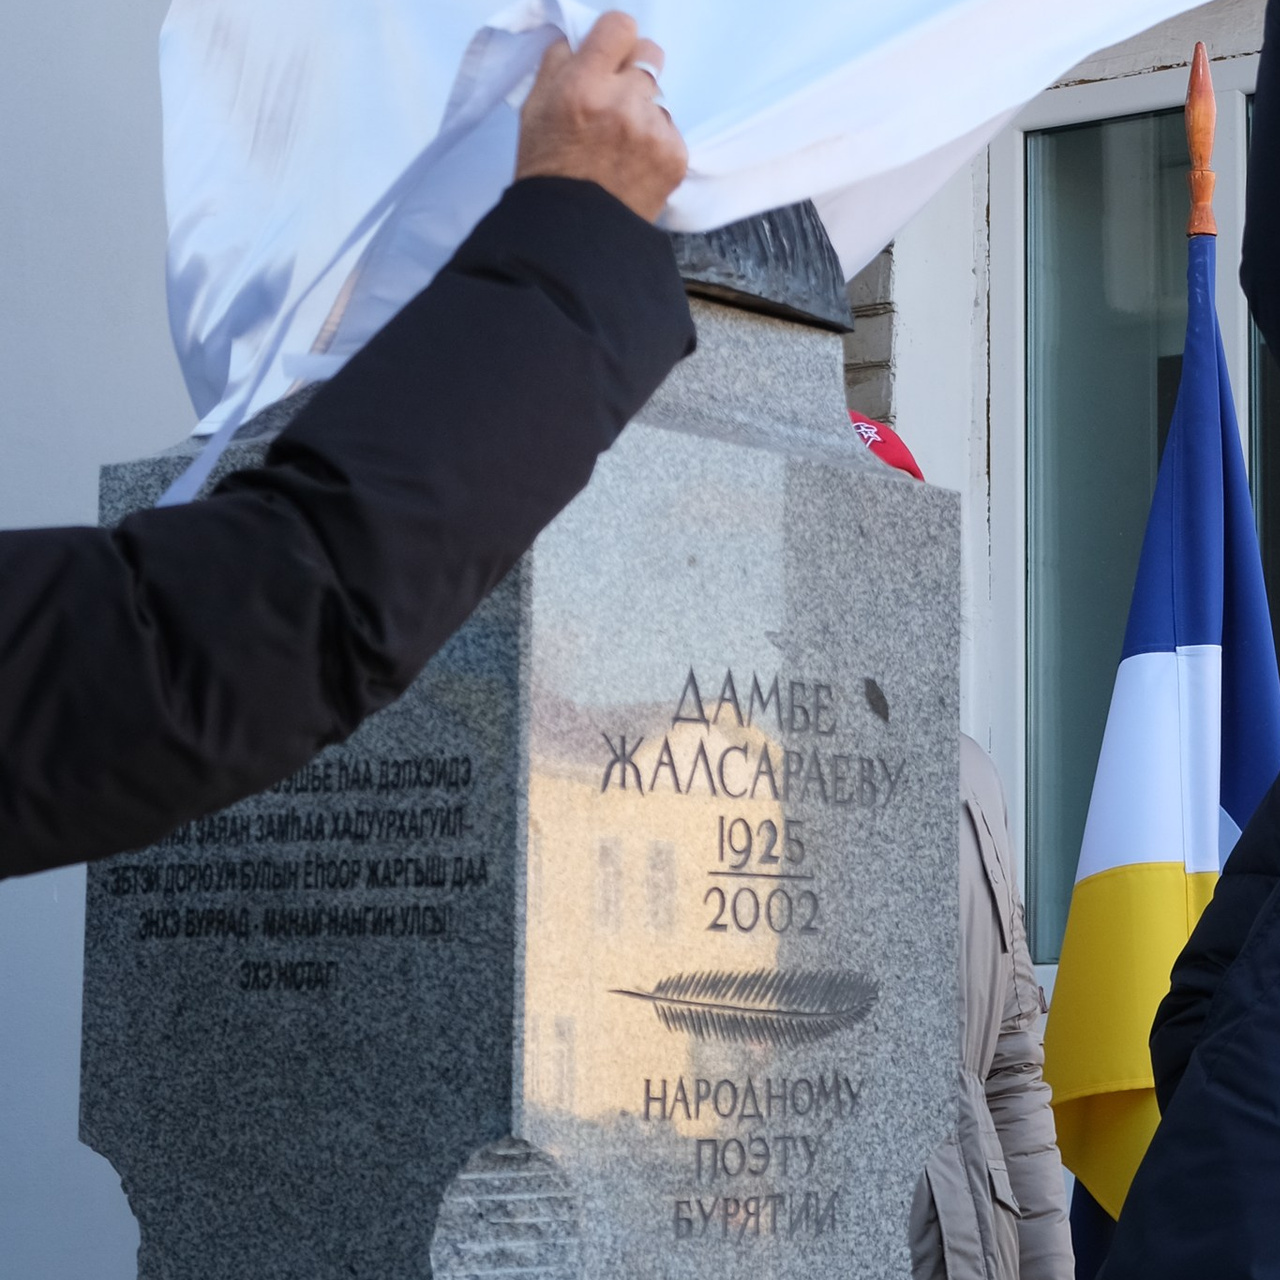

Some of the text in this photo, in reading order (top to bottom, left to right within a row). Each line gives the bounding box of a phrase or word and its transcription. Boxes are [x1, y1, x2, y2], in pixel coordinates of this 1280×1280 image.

[671, 667, 837, 736] ДАМБЕ
[601, 732, 906, 808] ЖАЛСАРАЕВУ
[717, 815, 807, 869] 1925
[704, 886, 821, 935] 2002
[644, 1075, 864, 1122] НАРОДНОМУ
[696, 1134, 821, 1183] ПОЭТУ
[673, 1191, 840, 1244] БУРЯТИИ
